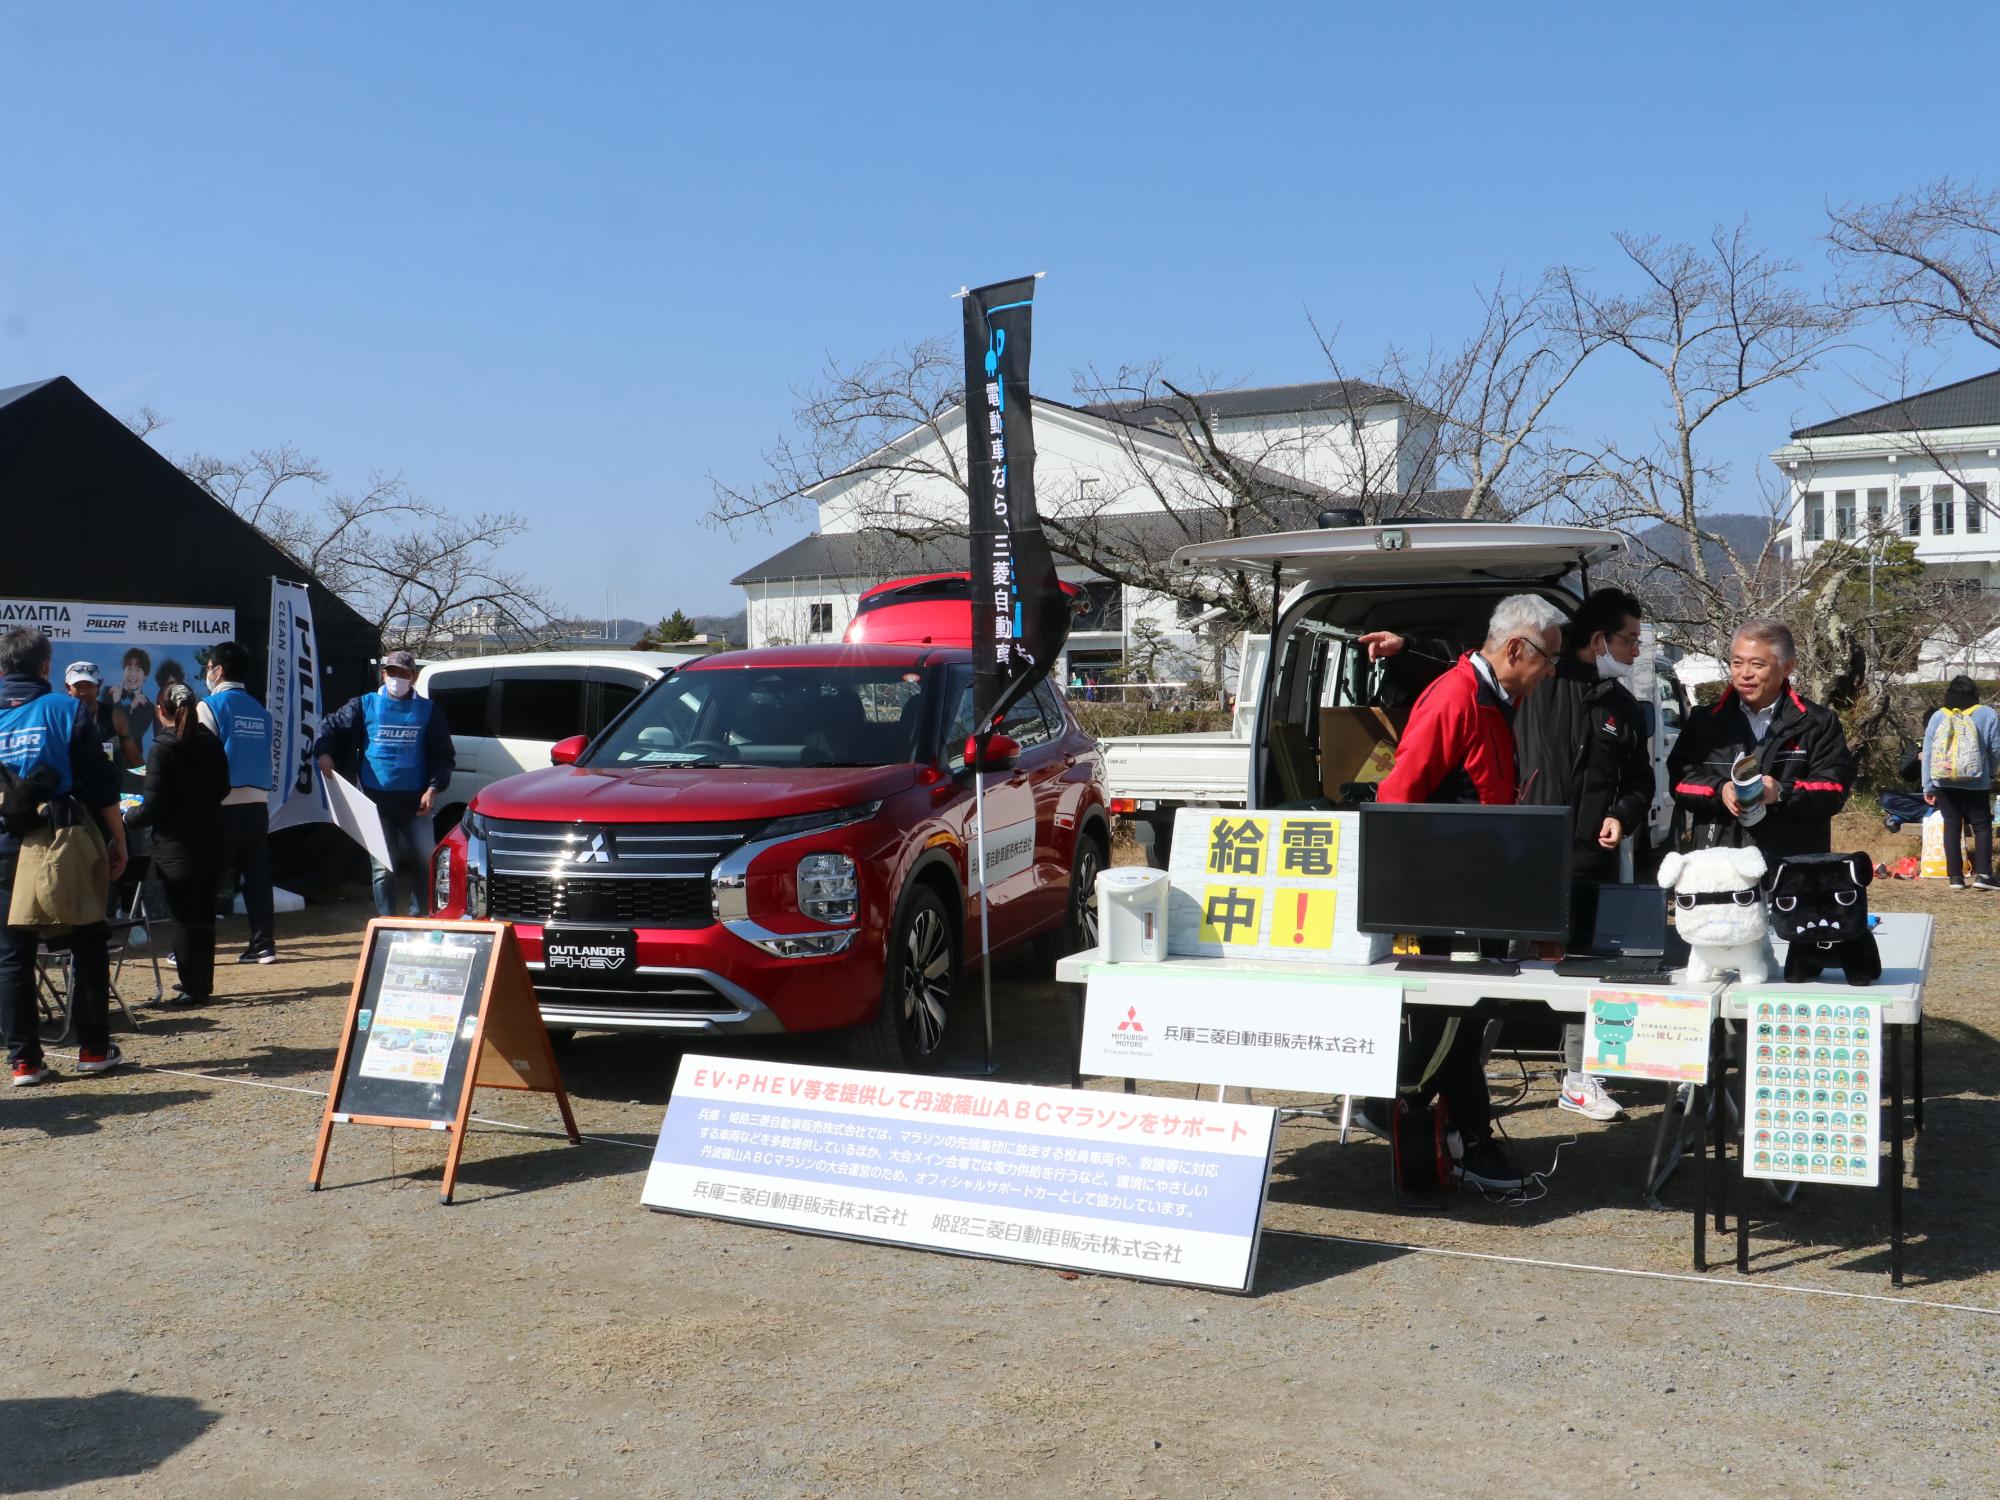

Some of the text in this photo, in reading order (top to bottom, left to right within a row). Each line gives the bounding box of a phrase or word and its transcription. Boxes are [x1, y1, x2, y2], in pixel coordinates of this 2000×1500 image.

[0, 604, 71, 621] AYAMA
[86, 619, 126, 629] PILLAR
[138, 619, 230, 634] 株式会社 PILLAR
[278, 601, 287, 651] CLEAN
[276, 656, 286, 715] SAFETY
[235, 720, 265, 730] PILLAR
[377, 729, 418, 738] PILLAR
[1209, 818, 1334, 876] 給電
[549, 944, 626, 957] OUTLANDER
[549, 956, 626, 969] PHEV
[1111, 1033, 1149, 1041] MITSUBISHI
[1163, 1024, 1375, 1056] 兵庫三菱自動車販売株式会社
[1115, 1040, 1143, 1049] MOTORS
[693, 1180, 1183, 1265] 兵庫三菱自動車販売株式会社 姫路三菱自動車販売株式会社
